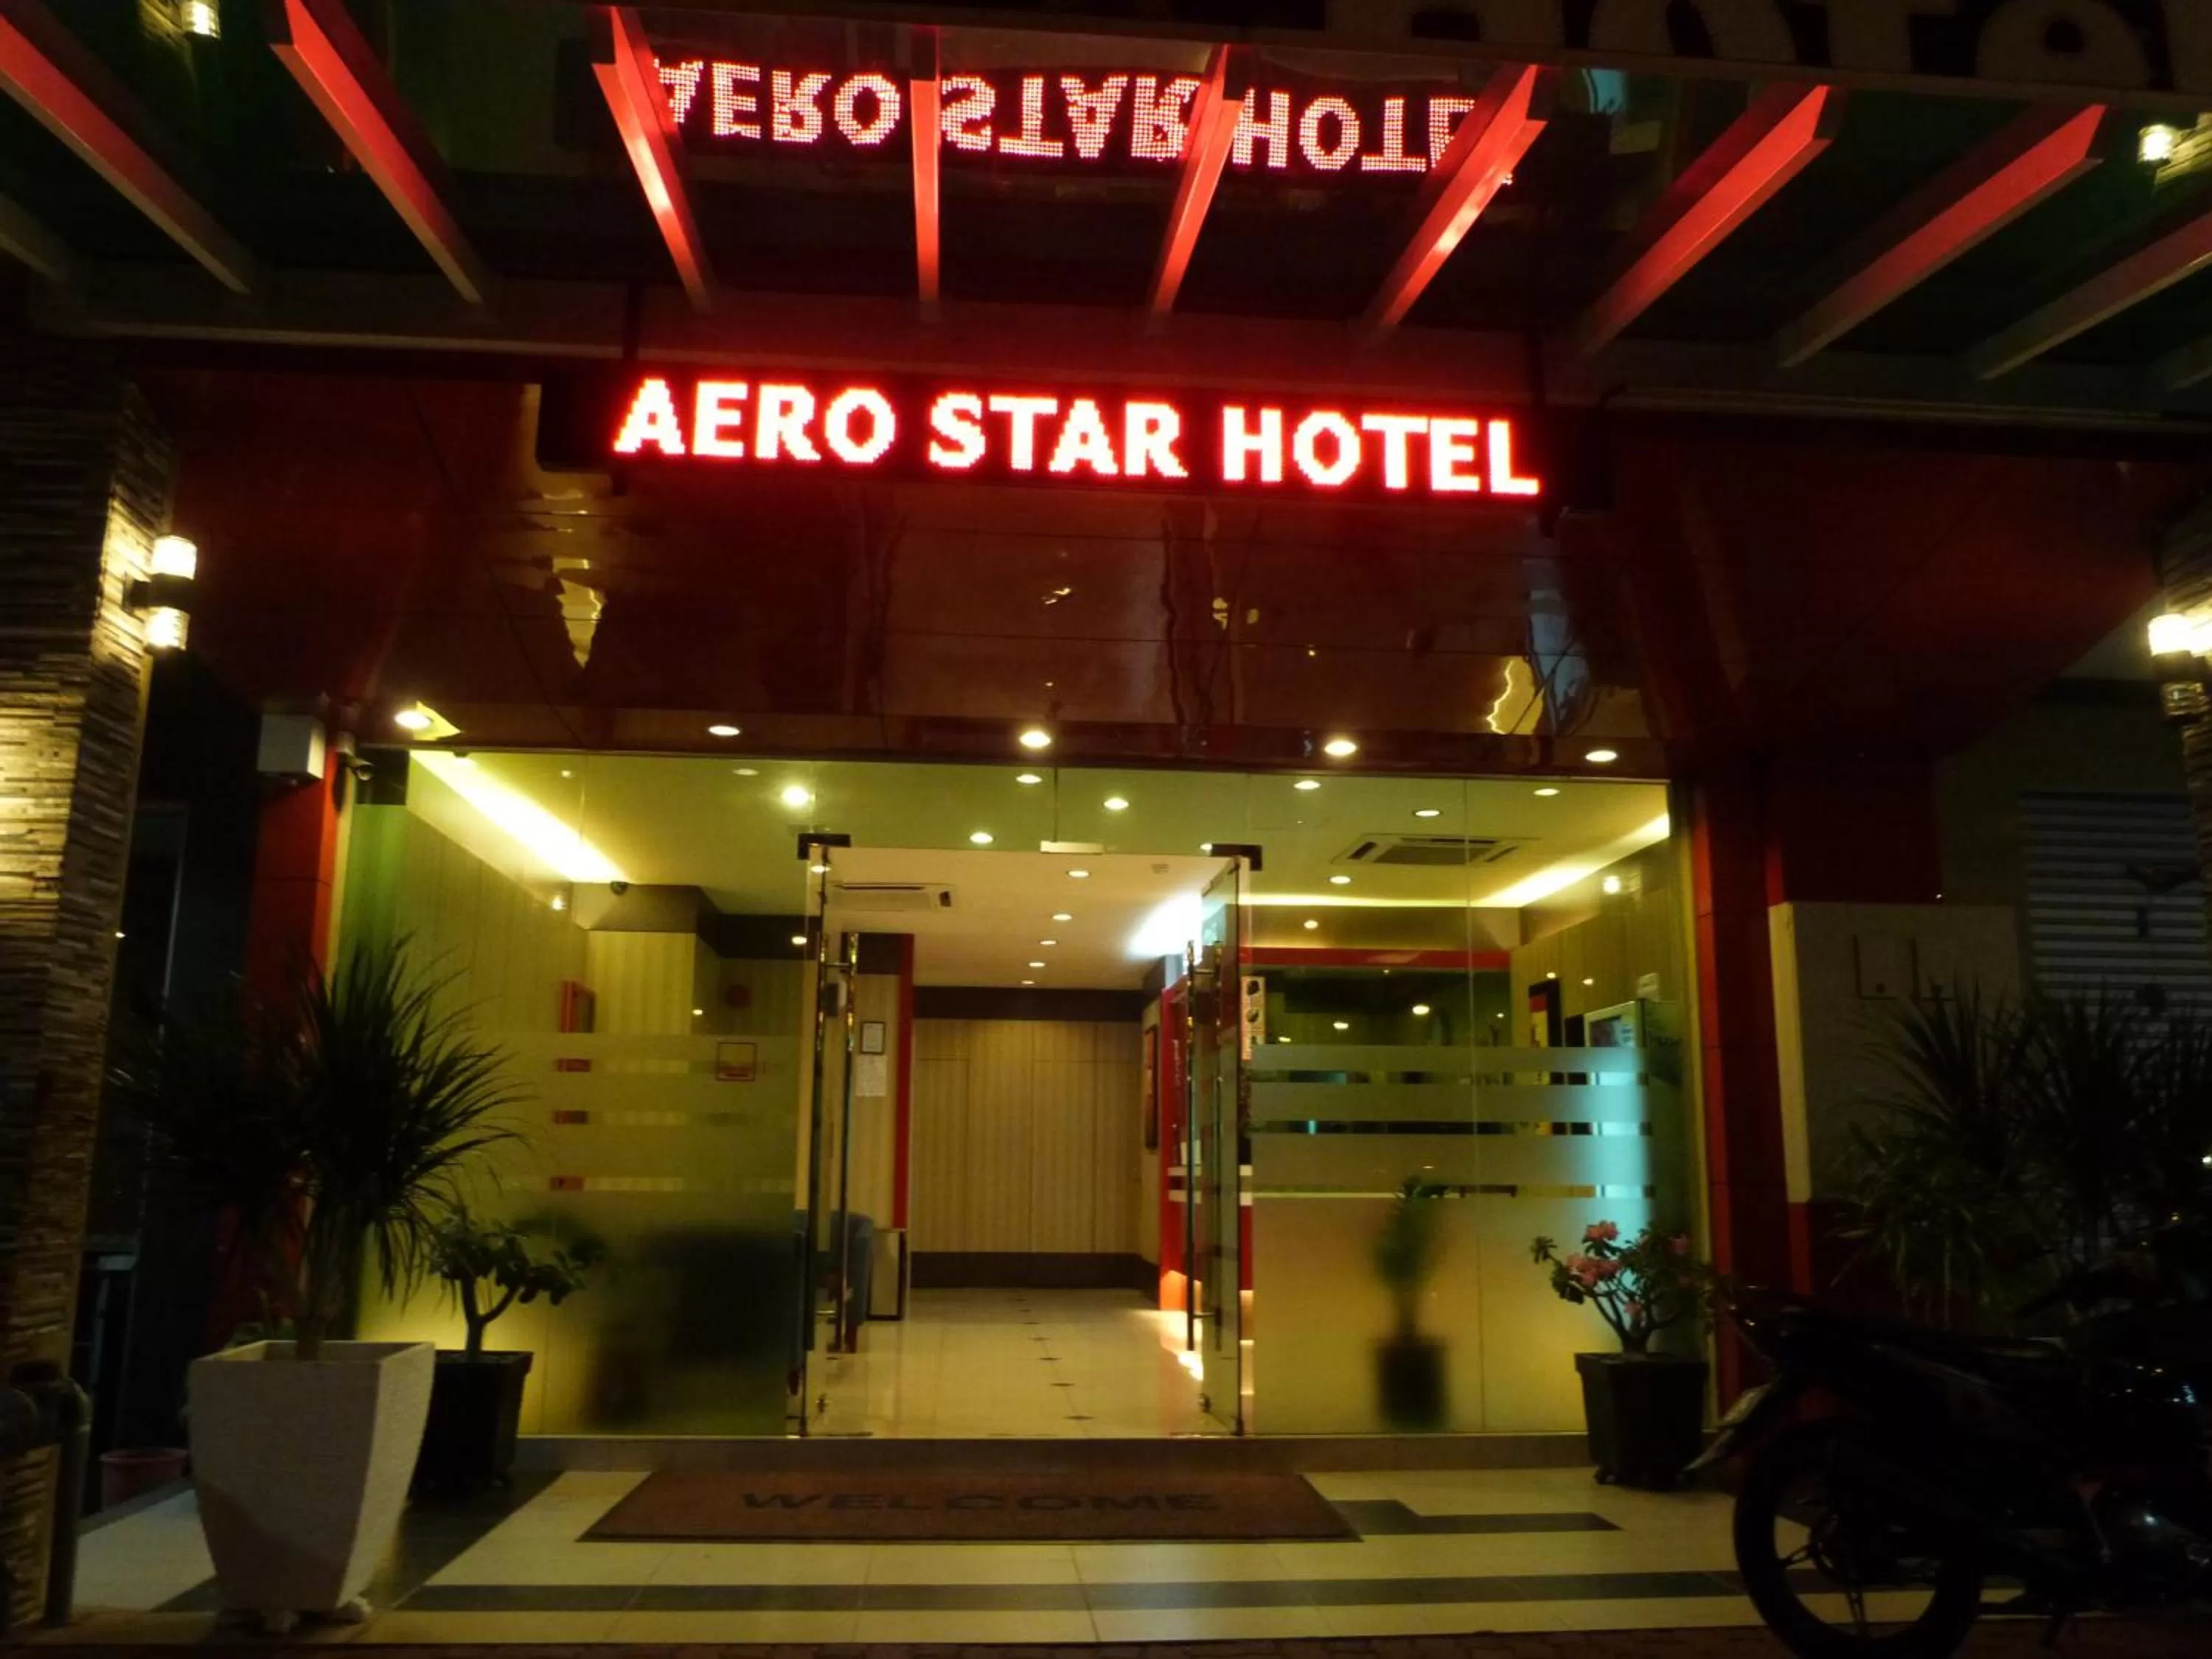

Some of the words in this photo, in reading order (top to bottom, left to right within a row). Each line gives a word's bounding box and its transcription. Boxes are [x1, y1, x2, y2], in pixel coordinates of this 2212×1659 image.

[613, 378, 897, 465] AERO
[928, 392, 1189, 479] STAR
[1222, 406, 1540, 496] HOTEL
[742, 1492, 1220, 1512] WELCOME
